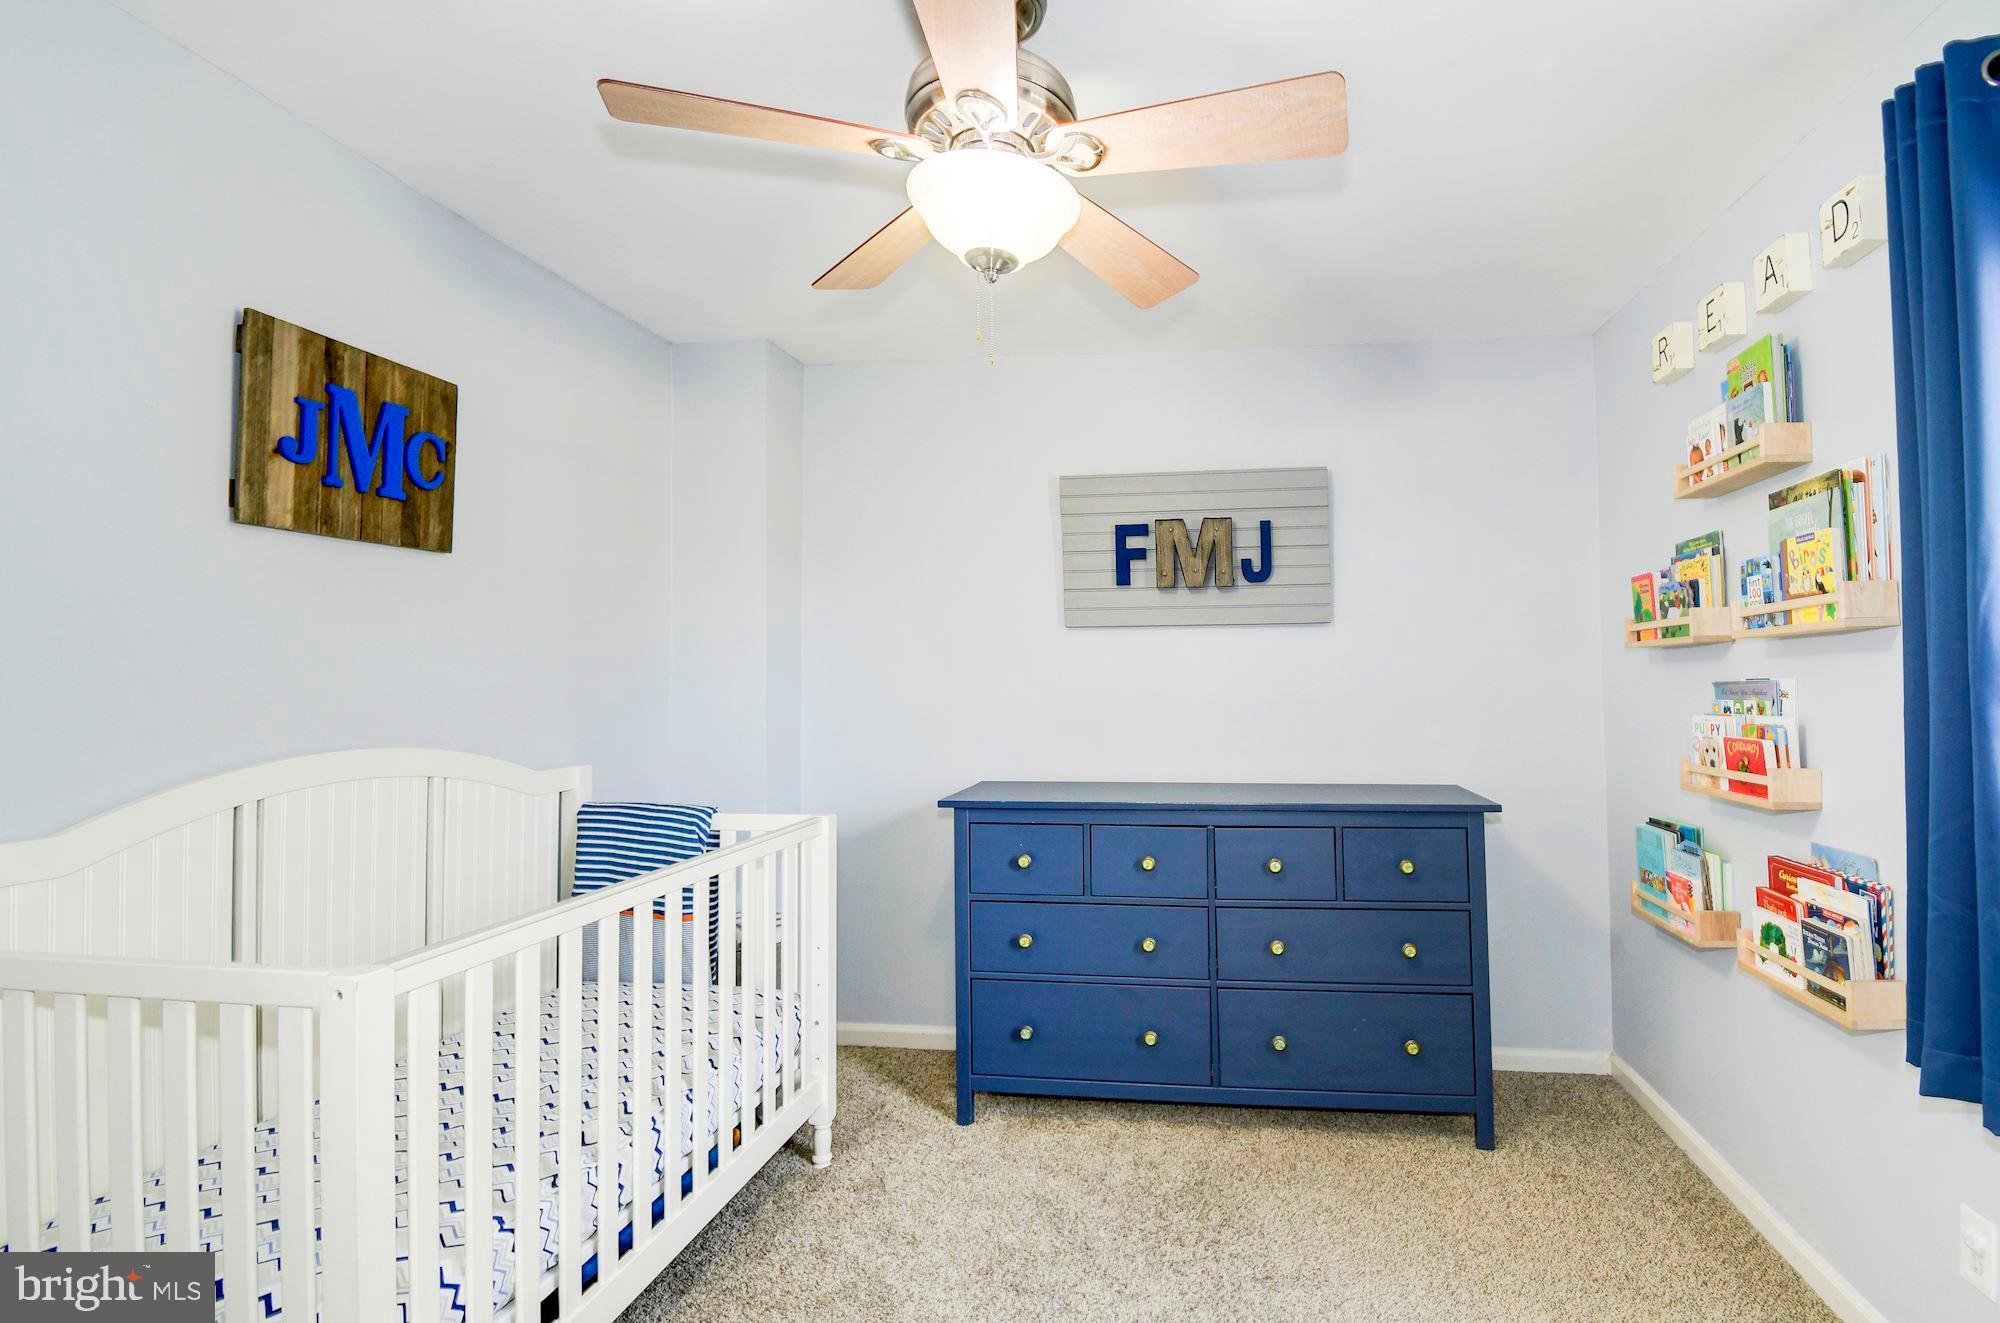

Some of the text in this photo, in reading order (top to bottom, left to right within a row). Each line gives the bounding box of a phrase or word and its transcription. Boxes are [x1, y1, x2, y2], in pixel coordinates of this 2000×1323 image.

[1789, 546, 1826, 570] Birds
[1748, 587, 1762, 599] 100
[1694, 722, 1720, 736] PUPPY
[1727, 740, 1760, 760] CORDUROY
